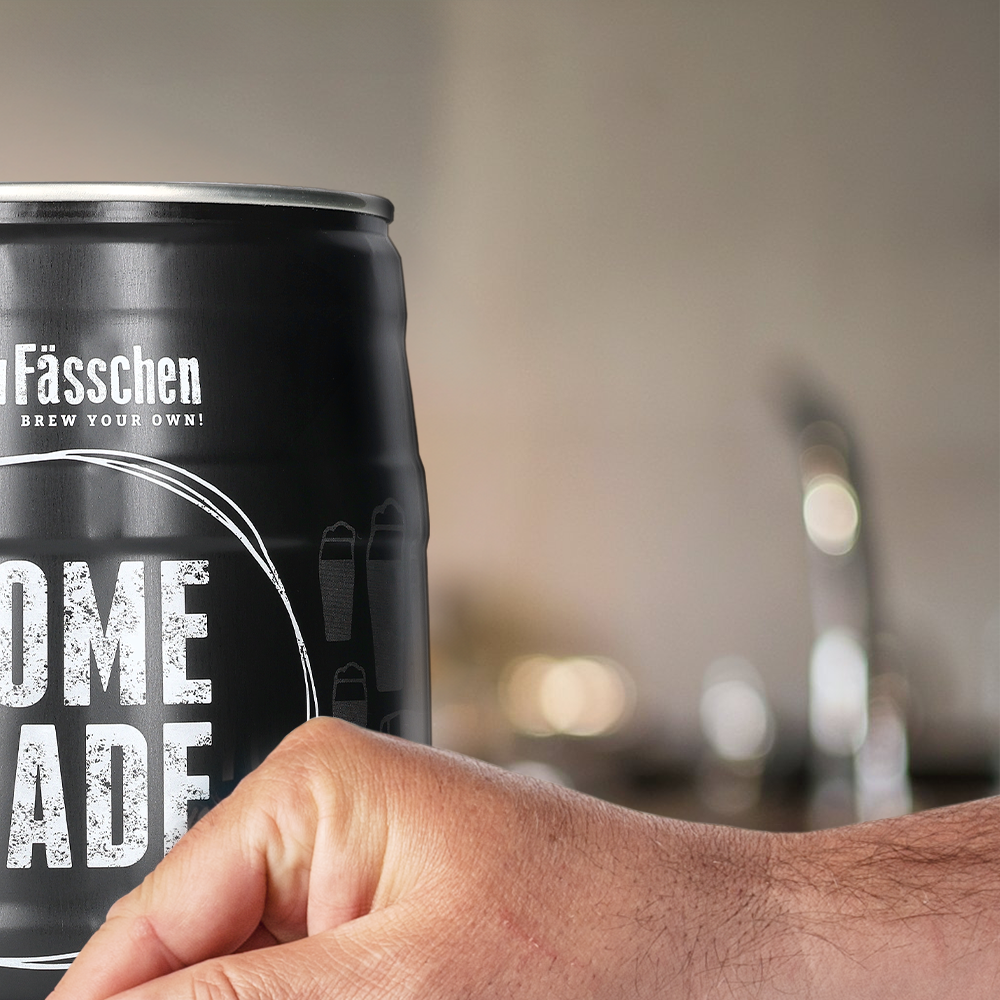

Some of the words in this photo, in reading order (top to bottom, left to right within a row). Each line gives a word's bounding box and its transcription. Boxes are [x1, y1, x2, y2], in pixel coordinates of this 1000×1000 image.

[20, 413, 77, 427] BREW
[87, 413, 142, 427] YOUR
[152, 413, 204, 427] OWN!
